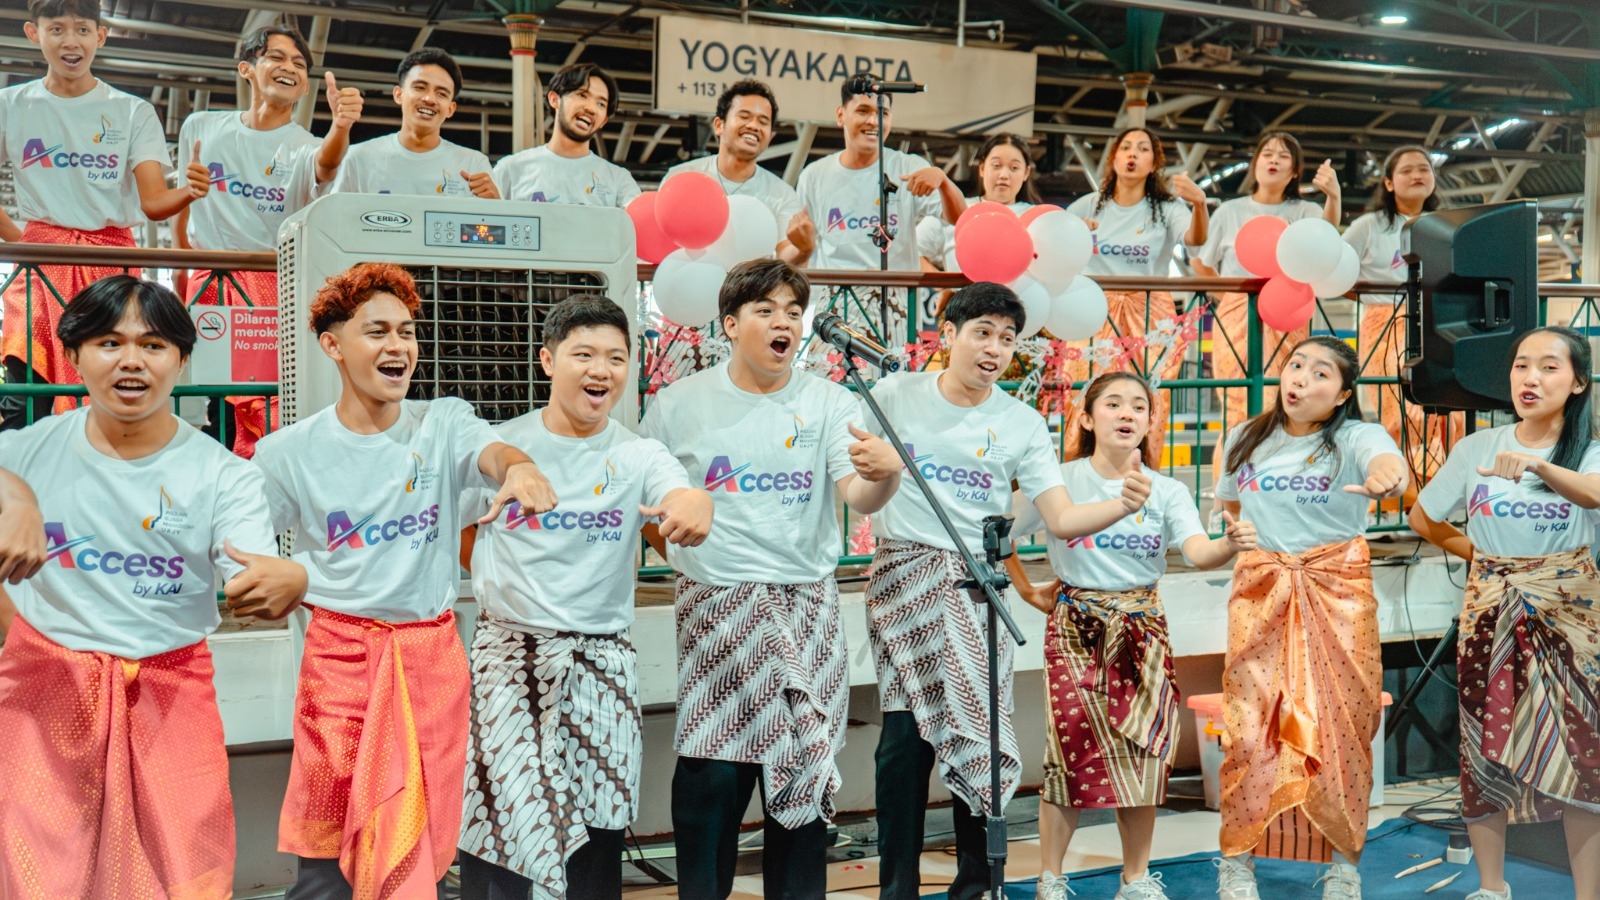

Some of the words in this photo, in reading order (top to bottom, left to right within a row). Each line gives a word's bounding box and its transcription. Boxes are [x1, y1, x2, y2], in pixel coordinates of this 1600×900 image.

[679, 38, 913, 83] YOGYAKARTA
[693, 81, 717, 97] 113
[20, 138, 119, 169] Access
[87, 170, 100, 181] by
[101, 171, 118, 180] KAI
[207, 161, 286, 202] Access
[257, 203, 268, 213] by
[268, 204, 285, 213] KAI
[827, 207, 899, 233] Acces
[1126, 257, 1136, 265] by
[234, 313, 278, 325] Dilaran
[234, 339, 251, 350] No
[704, 455, 813, 493] Access
[1237, 462, 1332, 494] Access
[781, 494, 795, 507] by
[796, 492, 812, 504] KAI
[956, 488, 970, 501] by
[970, 490, 991, 502] KAI
[1296, 494, 1309, 505] by
[1310, 495, 1330, 504] KAI
[1469, 483, 1572, 520] Access
[160, 527, 182, 535] UAJY
[326, 503, 440, 553] Access
[1534, 522, 1549, 533] by
[1550, 522, 1571, 532] KAI
[410, 537, 422, 551] by
[586, 532, 600, 544] by
[601, 531, 623, 542] KAI
[43, 521, 185, 580] Access
[132, 581, 152, 598] by
[154, 582, 184, 596] KAI
